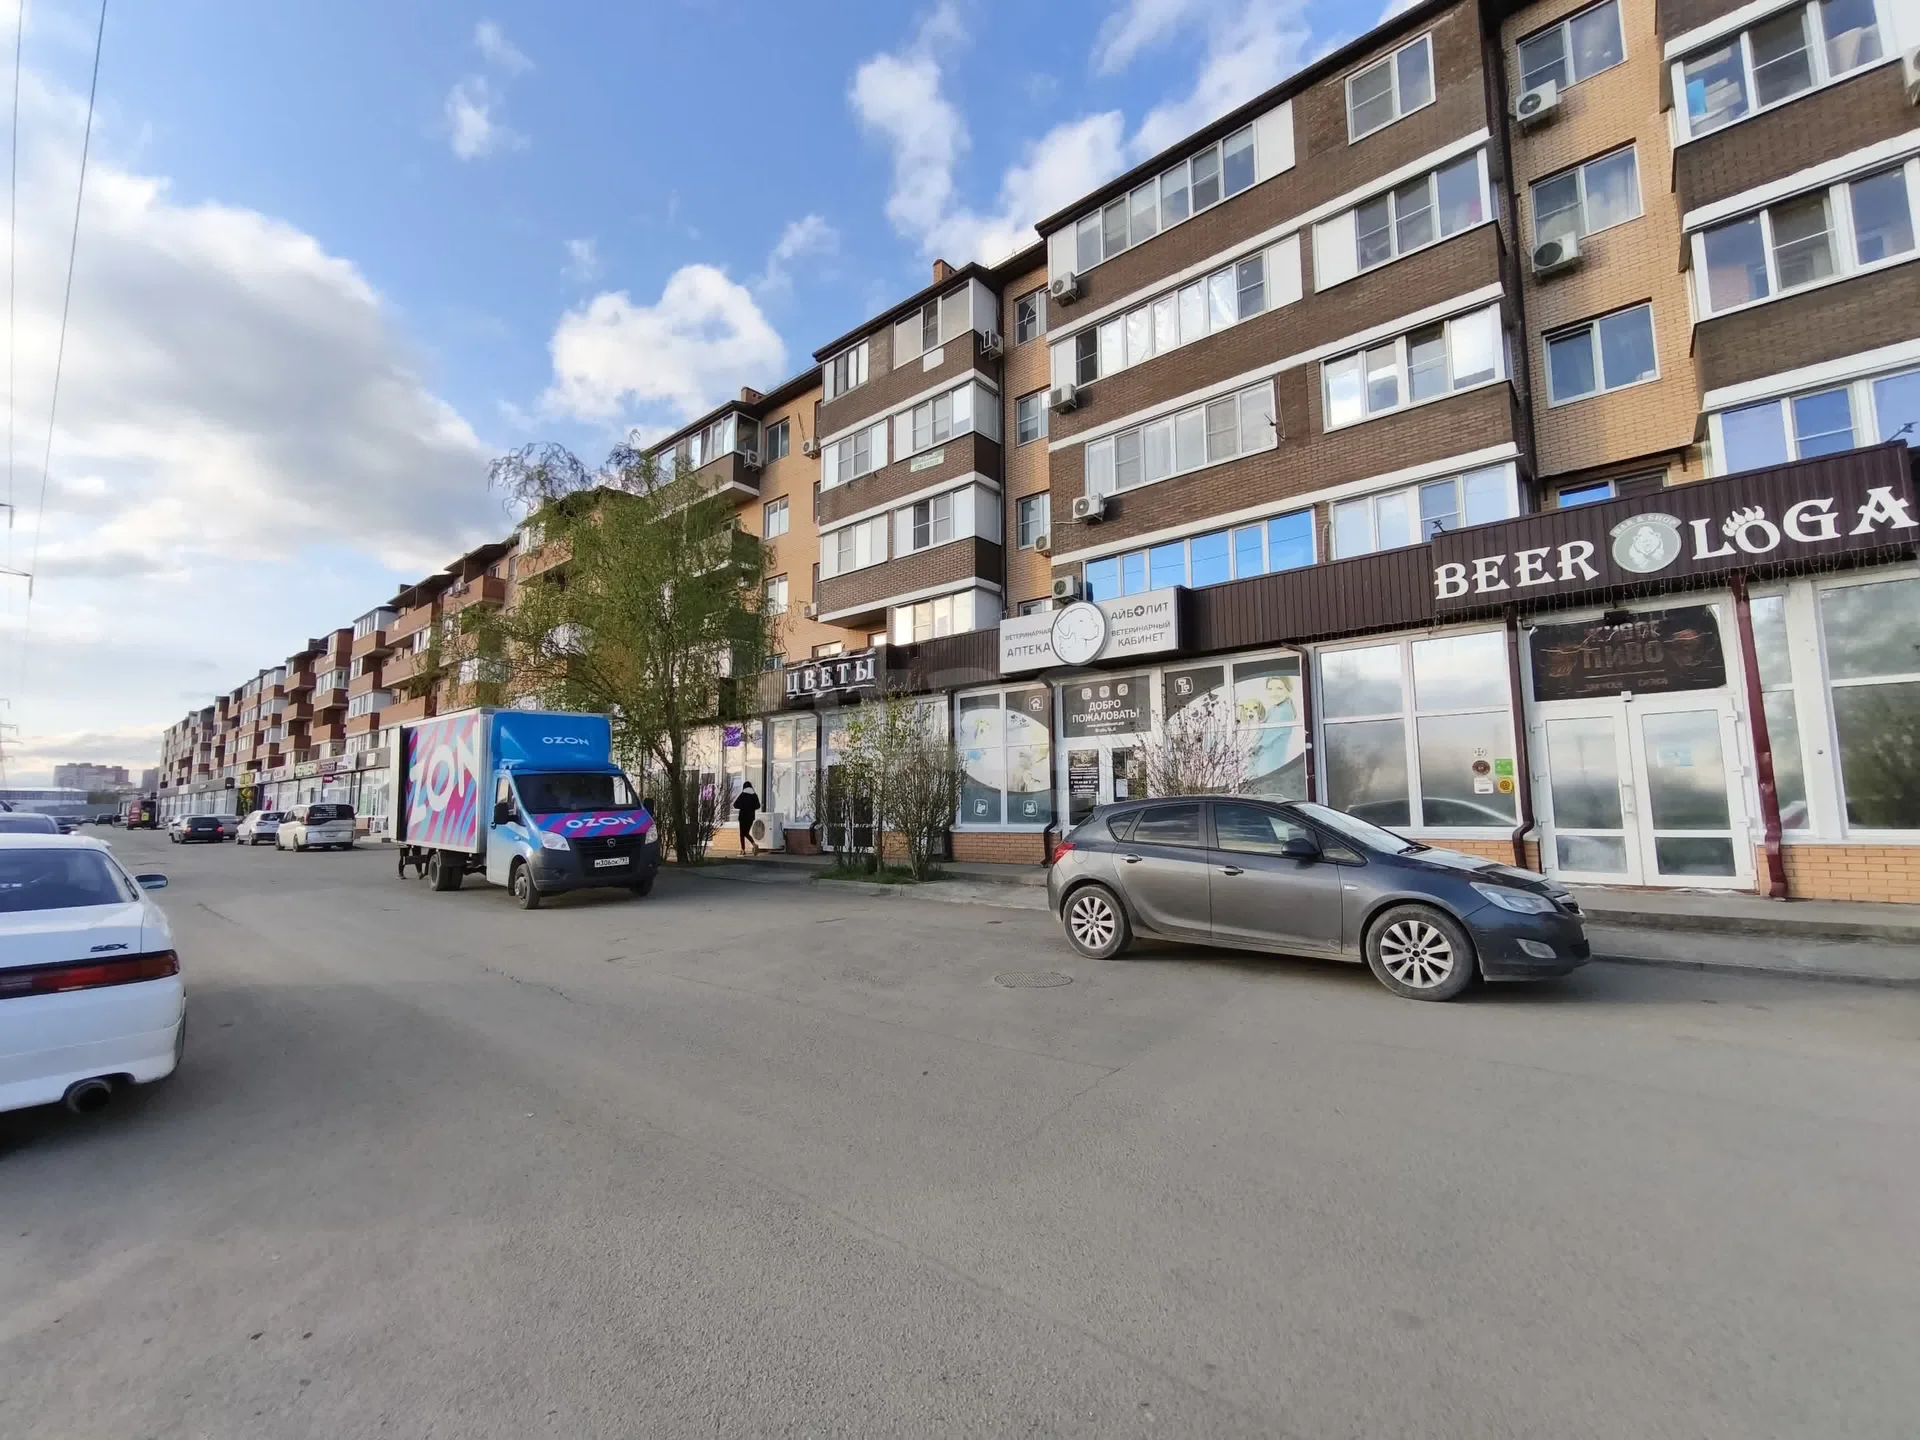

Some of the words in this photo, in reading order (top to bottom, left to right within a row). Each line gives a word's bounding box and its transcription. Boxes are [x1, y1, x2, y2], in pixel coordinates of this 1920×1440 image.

[1435, 540, 1600, 600] BEER
[1689, 486, 1919, 560] LOGA
[1110, 602, 1169, 621] АЙБОЛИТ
[1111, 620, 1171, 637] ВЕТЕРИНАРНЫЙ
[1117, 632, 1165, 647] КАБИНЕТ
[1007, 642, 1051, 658] АПТЕКА
[786, 658, 876, 695] ЦВЕТЫ
[1088, 699, 1121, 712] ДОБРО
[1072, 708, 1140, 723] ПОЖАЛОВАТЬ!
[542, 736, 590, 746] OZON
[566, 816, 636, 829] OZON
